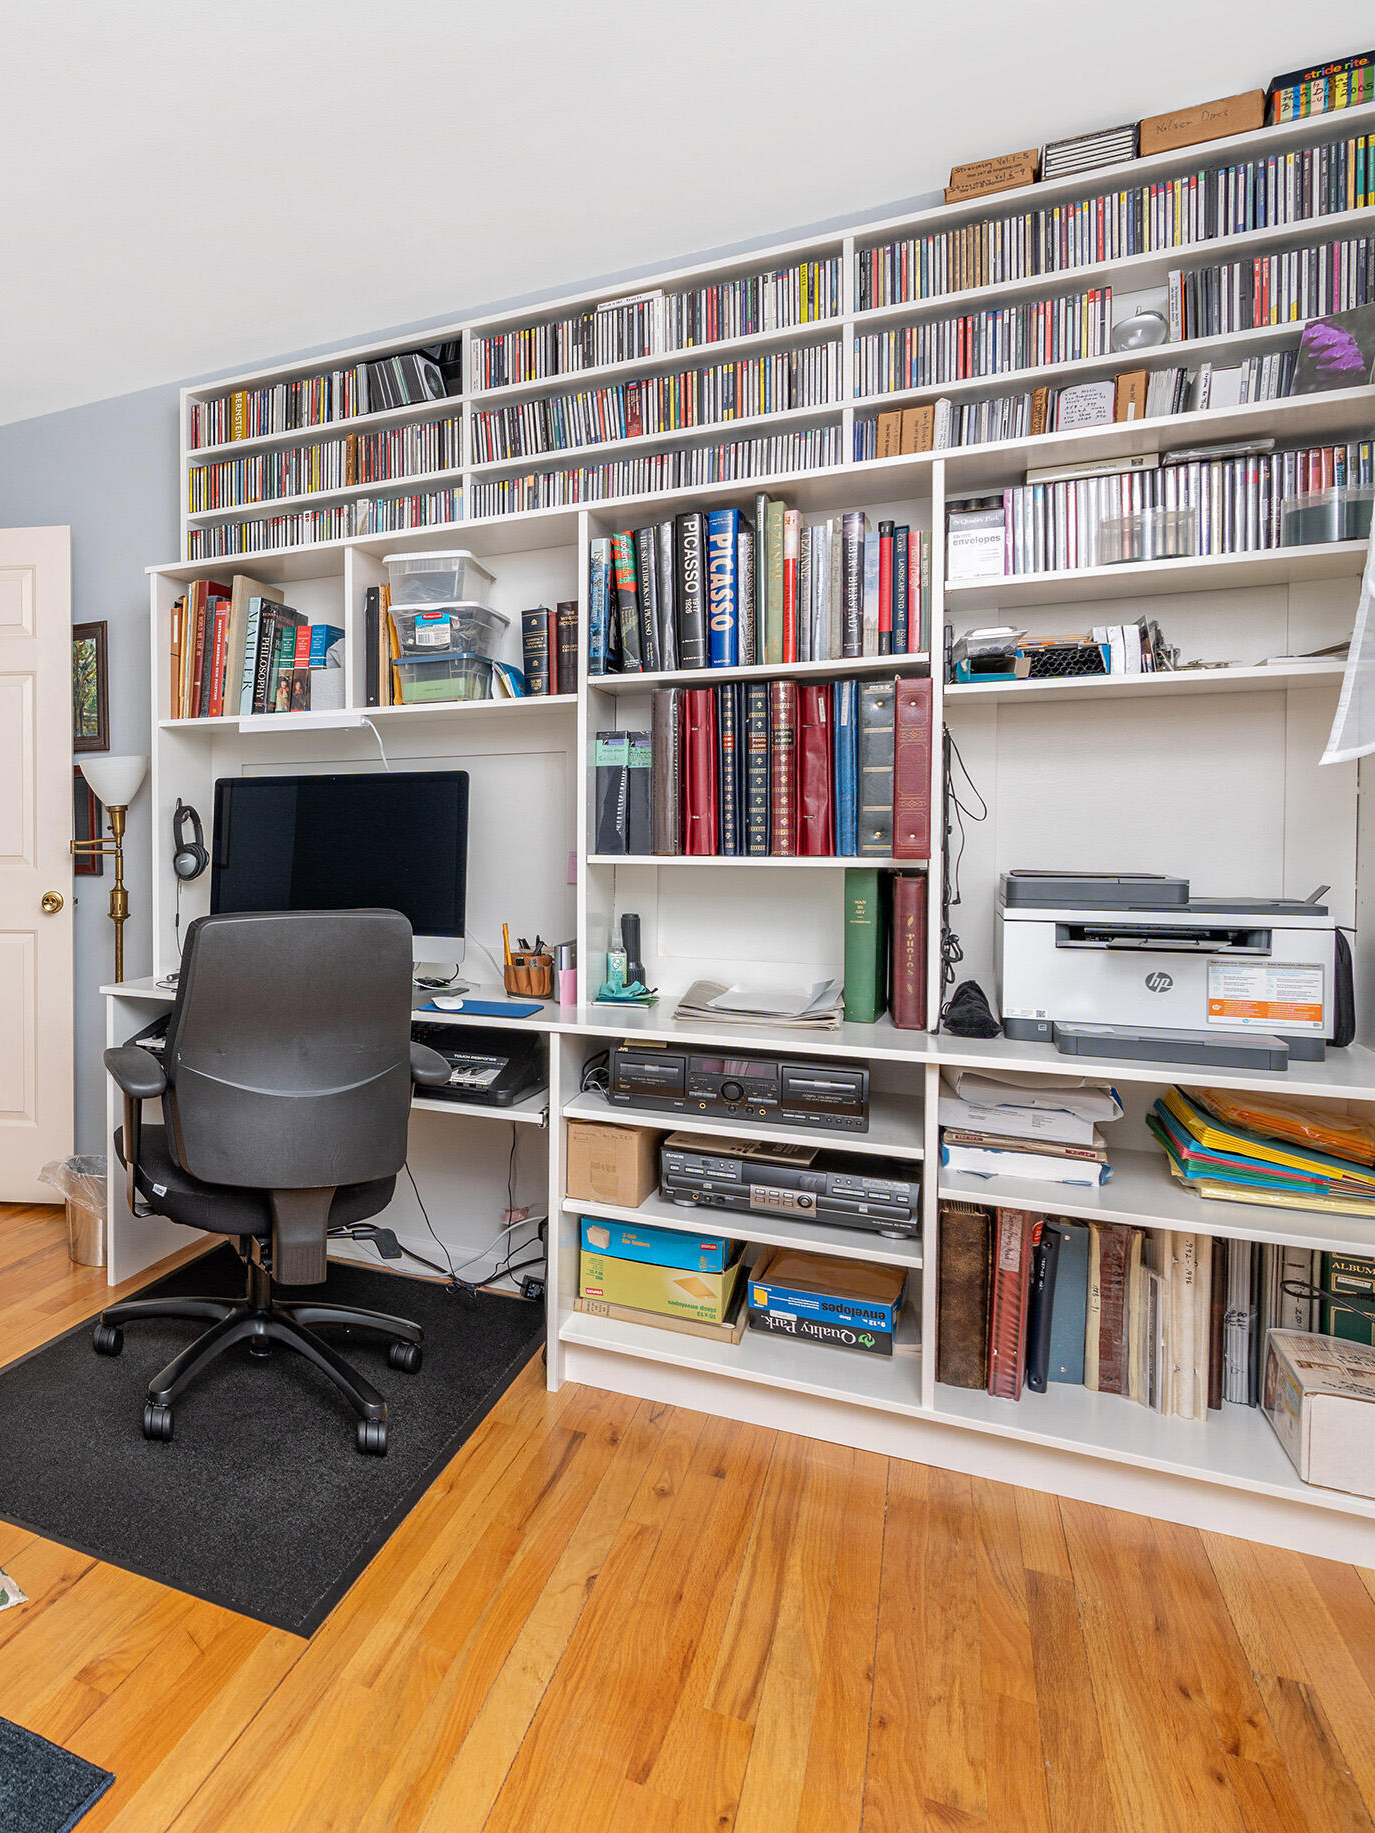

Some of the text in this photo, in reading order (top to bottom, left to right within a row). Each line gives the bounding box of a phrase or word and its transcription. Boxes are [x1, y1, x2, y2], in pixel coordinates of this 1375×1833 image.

[1304, 58, 1370, 80] stride rite
[235, 392, 243, 441] BERNSTEIN
[800, 531, 810, 580] CEZANNE
[952, 534, 1002, 547] envelopes
[682, 520, 700, 594] PICASSO
[709, 531, 735, 632] PICASSO
[847, 531, 859, 634] ALBERT BIERSTADT
[897, 558, 906, 622] LANDSCAPE INTO ART
[691, 597, 700, 613] 1917
[643, 609, 653, 636] PICASSO
[241, 610, 258, 694] MAHLER
[256, 637, 270, 701] PHILOSOPHY
[905, 933, 916, 977] PHOTOS
[1147, 972, 1173, 993] hp
[1332, 1262, 1375, 1276] ALBUM
[667, 1300, 699, 1310] envelopes
[821, 1302, 886, 1322] envelopes
[1294, 1307, 1303, 1328] 2001
[761, 1315, 857, 1345] Quality Park.
